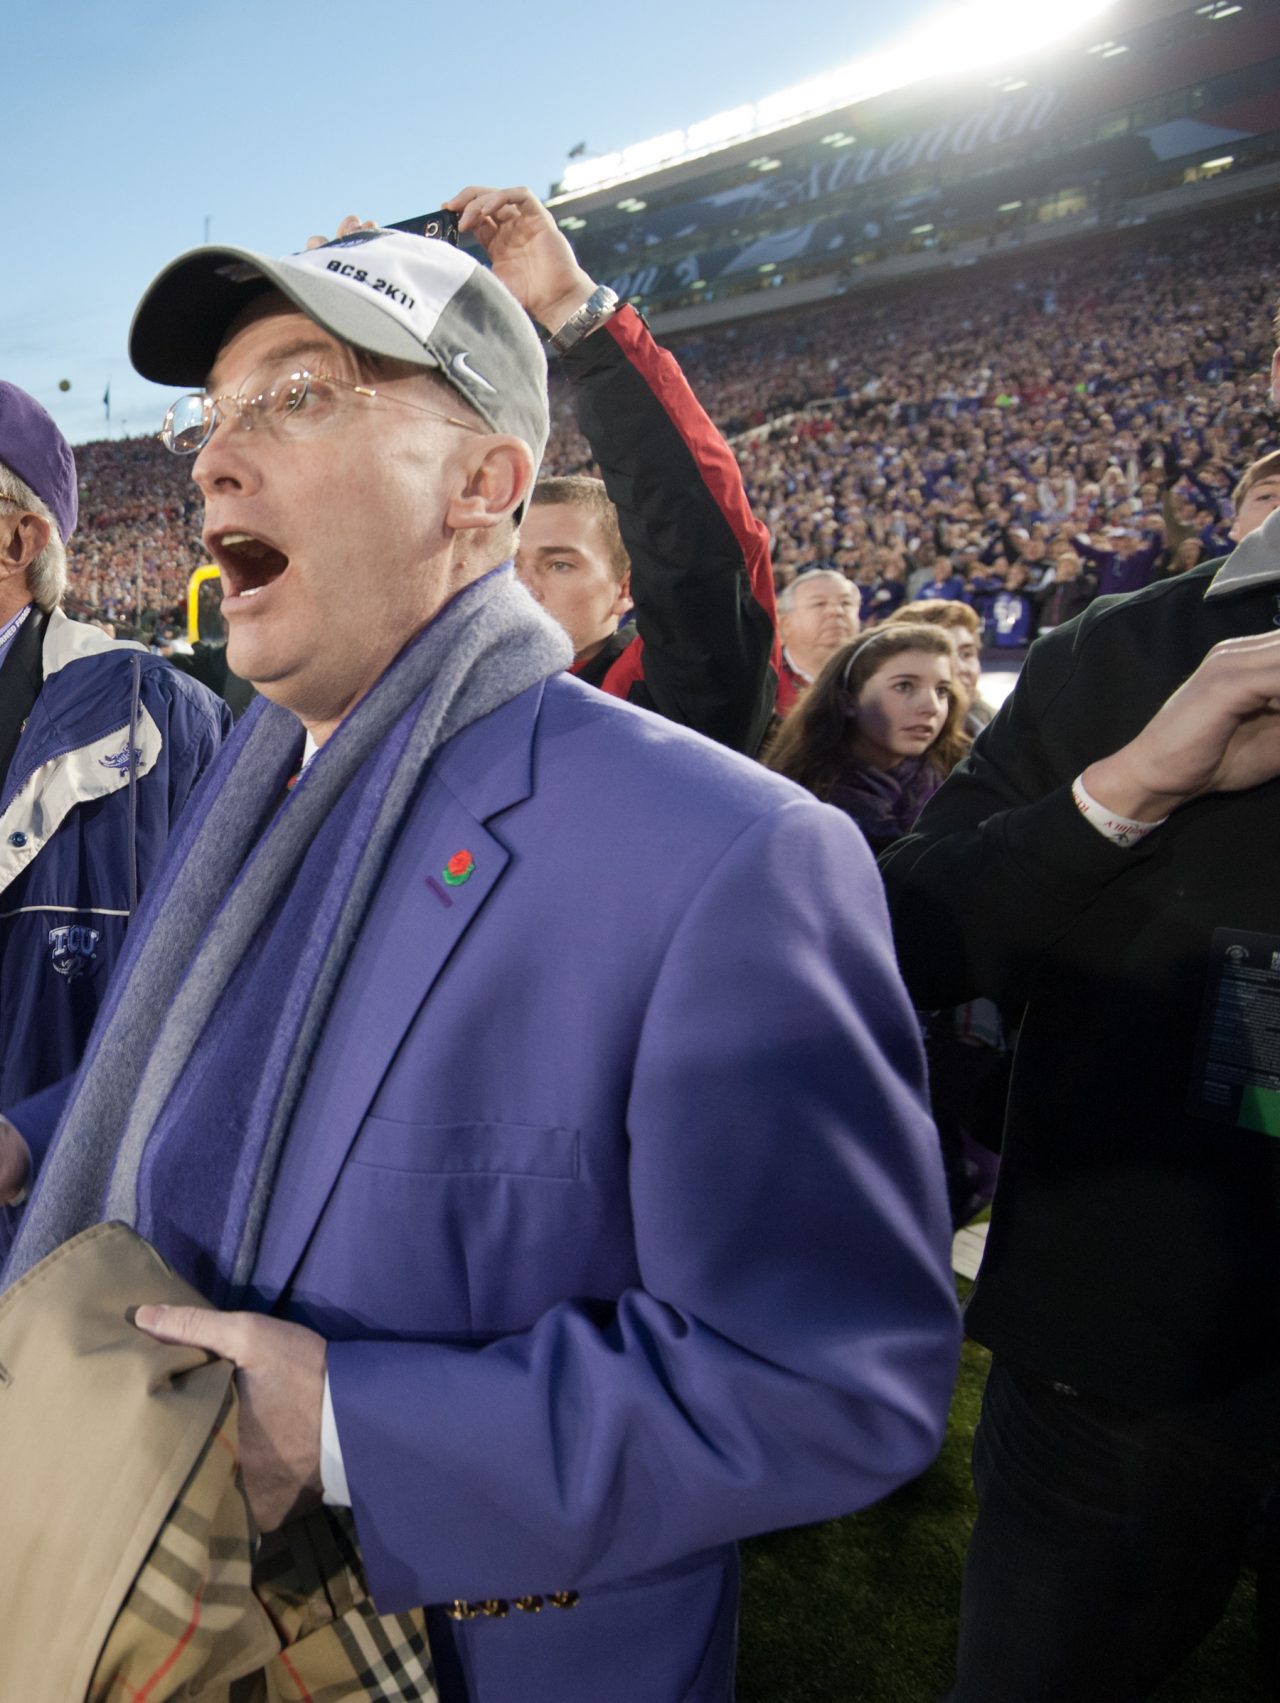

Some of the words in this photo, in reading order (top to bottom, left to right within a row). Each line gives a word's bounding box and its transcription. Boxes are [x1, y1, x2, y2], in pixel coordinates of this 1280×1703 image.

[325, 259, 369, 283] BCS
[371, 277, 416, 310] 2K11
[48, 924, 100, 958] TCU
